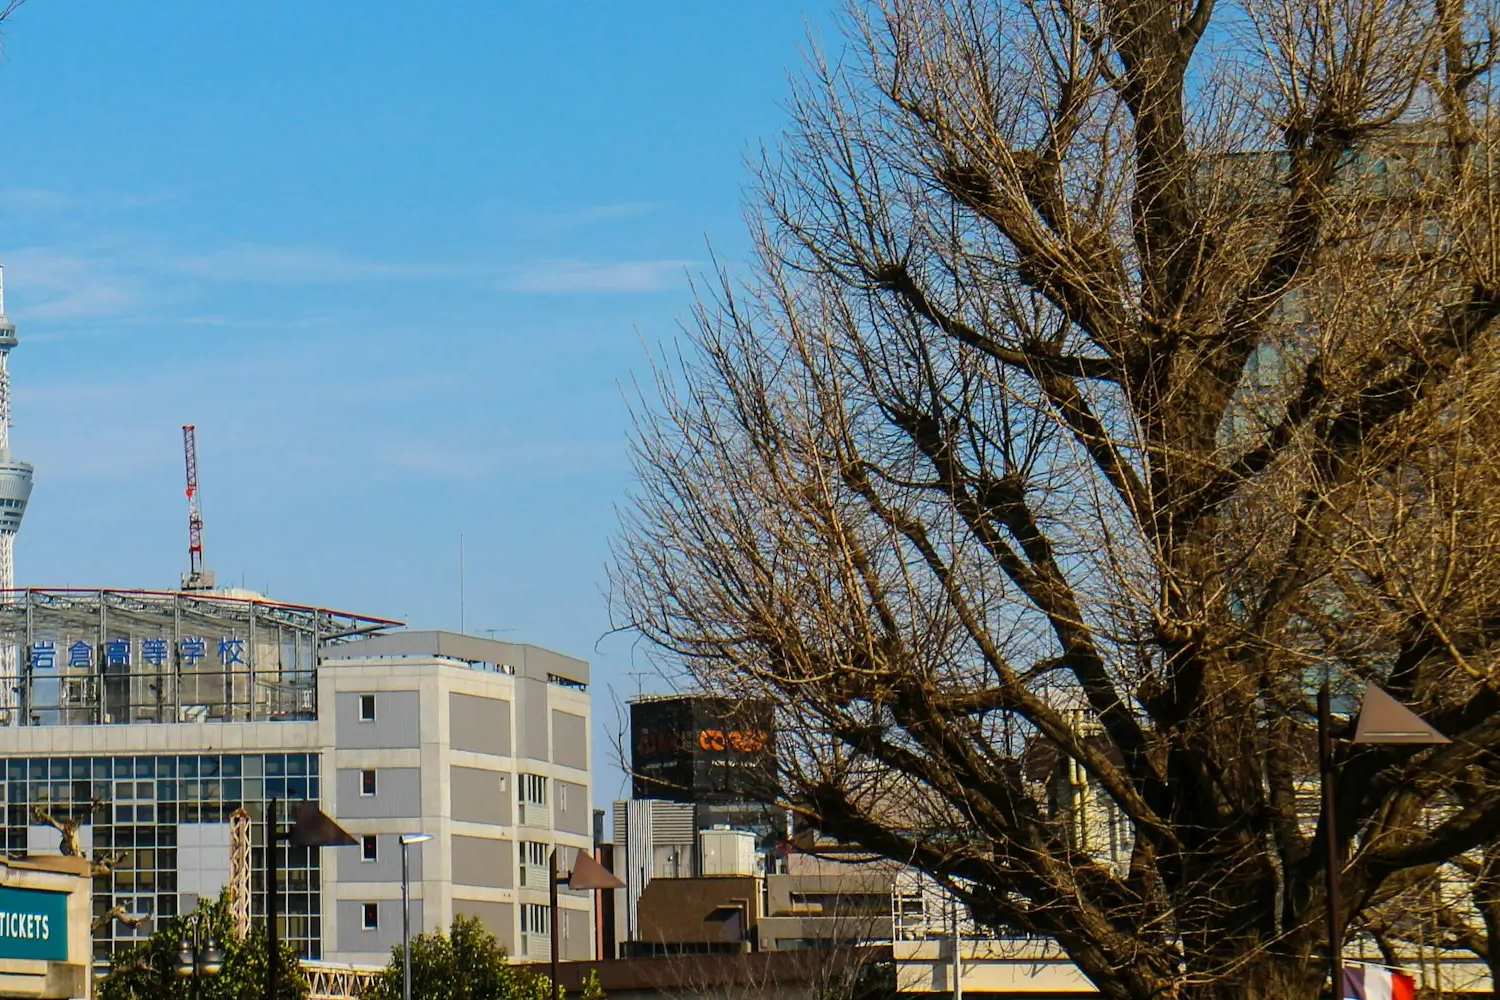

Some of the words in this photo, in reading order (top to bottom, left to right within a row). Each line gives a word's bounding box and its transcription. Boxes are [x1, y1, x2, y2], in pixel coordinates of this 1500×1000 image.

[32, 637, 246, 668] 岩倉高等学校
